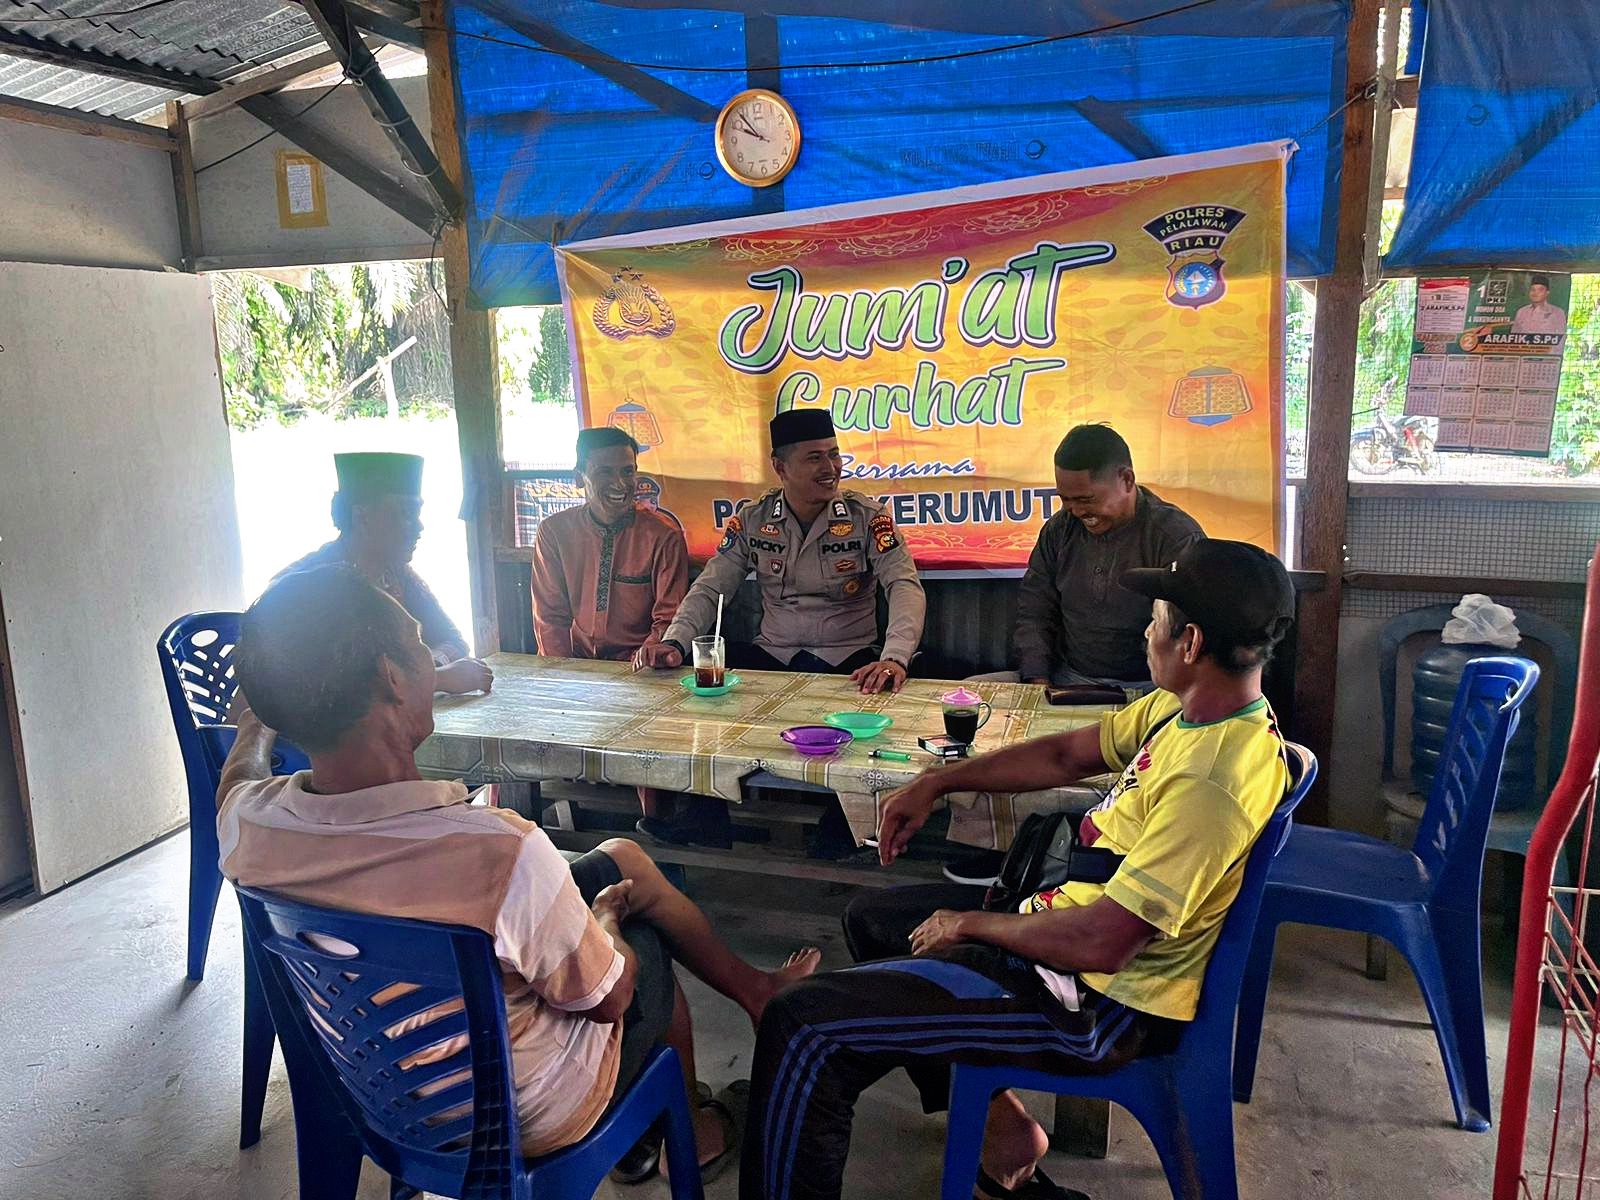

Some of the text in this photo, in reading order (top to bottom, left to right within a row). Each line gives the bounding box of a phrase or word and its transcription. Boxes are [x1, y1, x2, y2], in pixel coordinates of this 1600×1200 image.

[752, 103, 761, 113] 12
[737, 152, 744, 162] 8
[748, 162, 755, 172] 7
[1164, 207, 1225, 224] POLRES
[1160, 218, 1228, 237] PELALAWAN
[1170, 237, 1220, 251] RIAU
[1477, 285, 1486, 298] 1
[719, 241, 1117, 374] Jum'at
[1464, 335, 1473, 346] 2
[1484, 334, 1529, 346] ARAFIK,
[1533, 335, 1559, 344] S.Pd
[839, 455, 976, 480] Bersama
[750, 538, 786, 554] DICKY
[822, 541, 862, 554] POLRI
